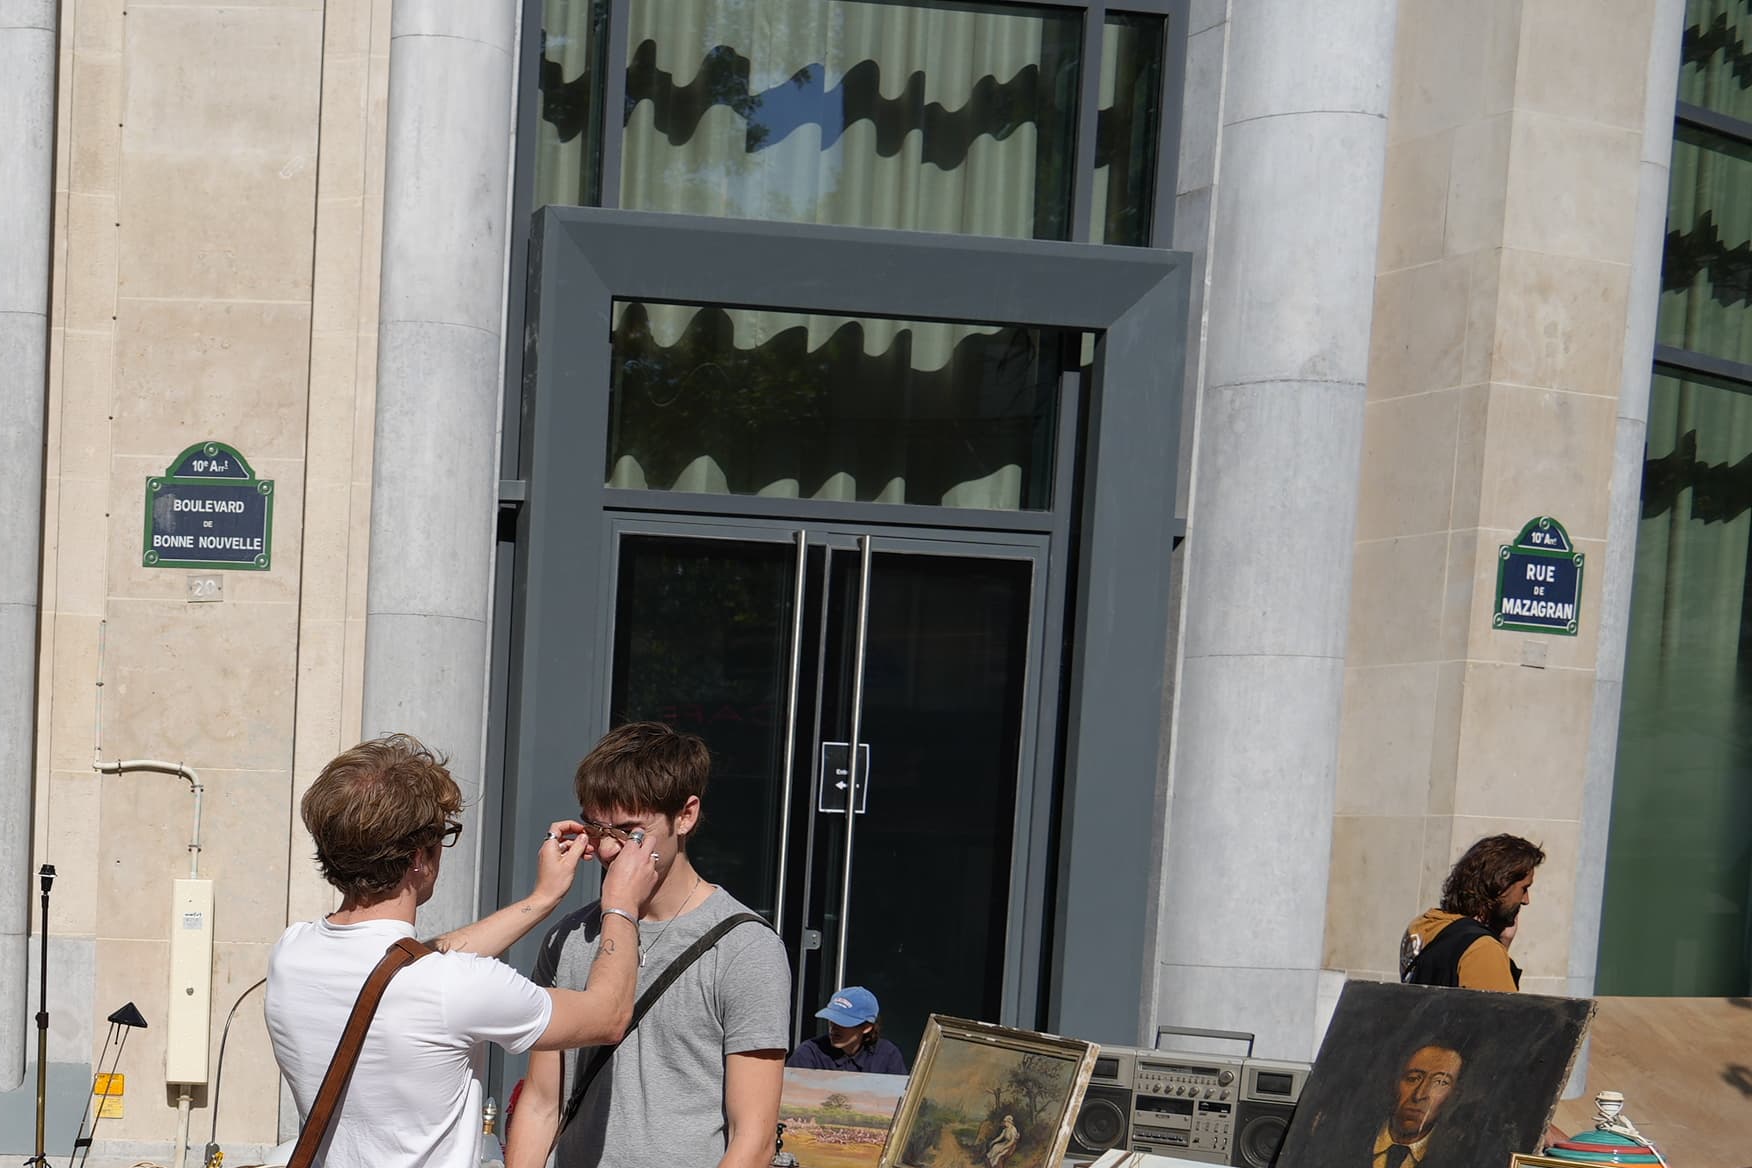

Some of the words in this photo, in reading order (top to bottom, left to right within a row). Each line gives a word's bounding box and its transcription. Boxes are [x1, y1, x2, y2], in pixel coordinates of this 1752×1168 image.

[173, 499, 245, 513] BOULEVARD
[203, 520, 213, 528] DE
[153, 535, 194, 549] BONNE
[199, 536, 262, 550] NOUVELLE
[1526, 563, 1556, 582] RUE
[1533, 586, 1545, 596] DE
[1502, 597, 1573, 620] MAZAGRAN
